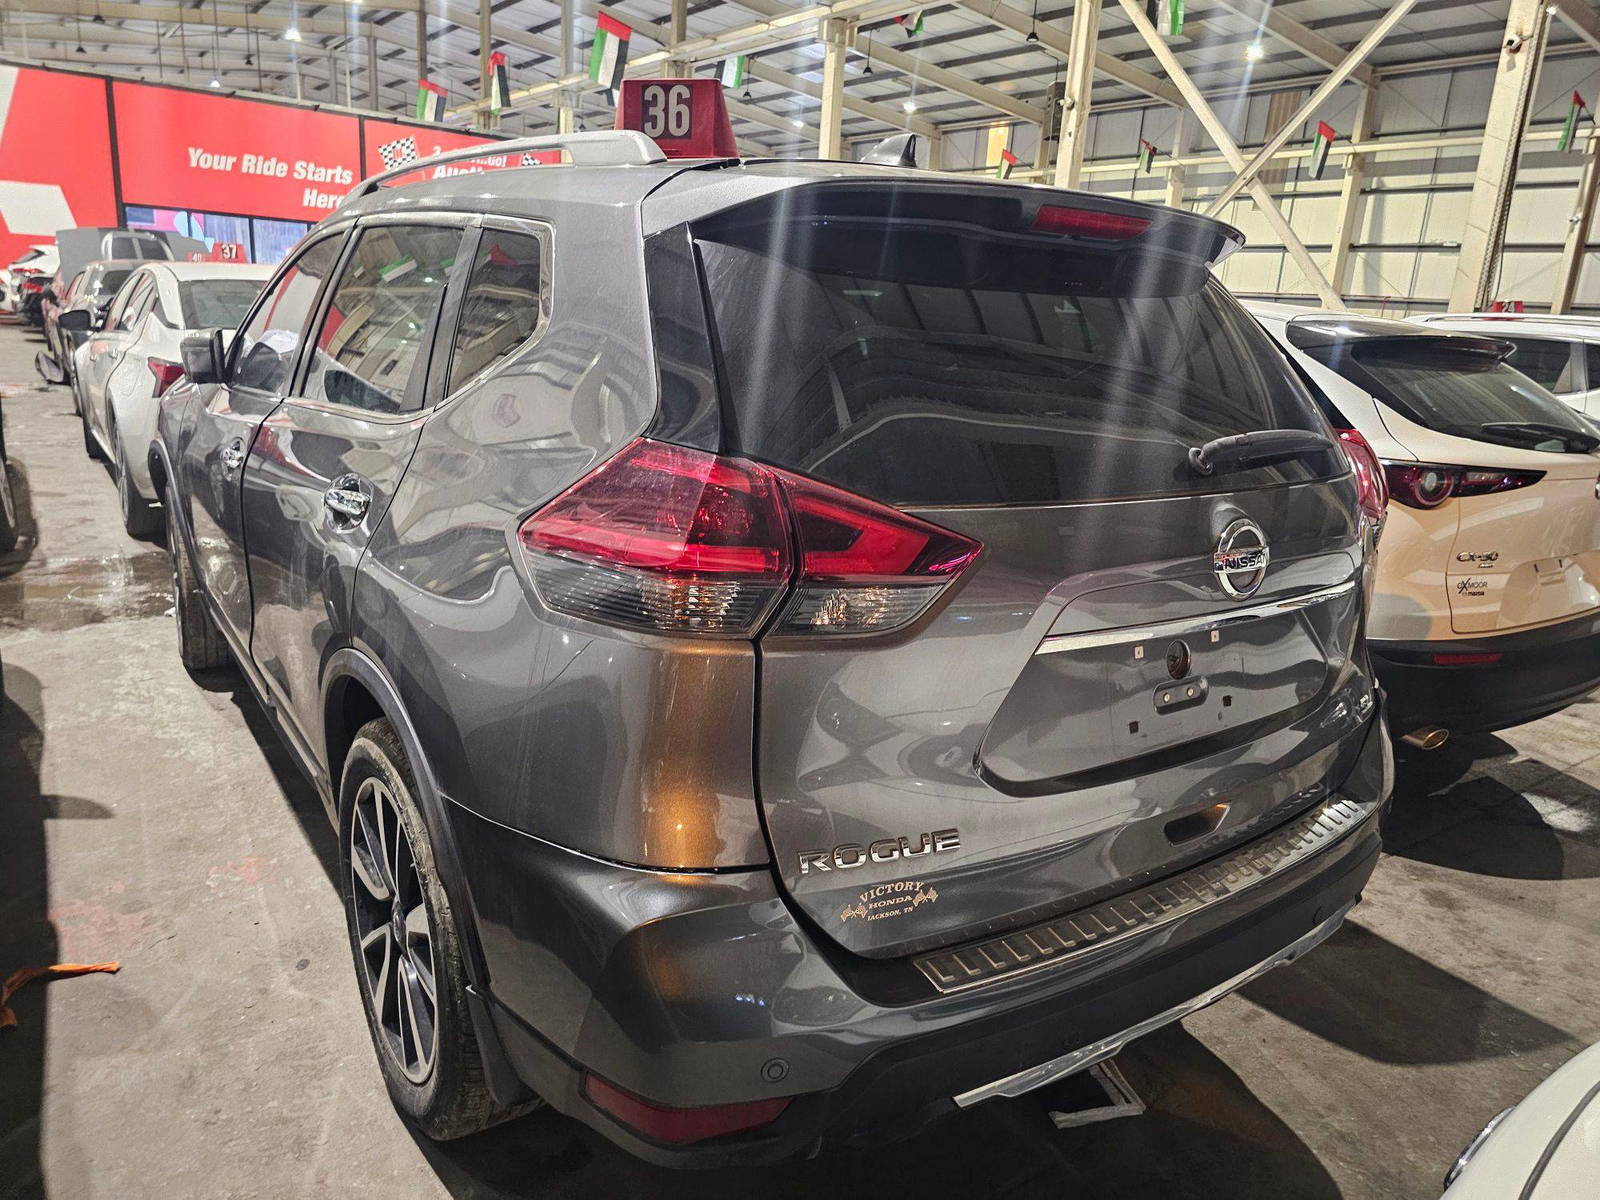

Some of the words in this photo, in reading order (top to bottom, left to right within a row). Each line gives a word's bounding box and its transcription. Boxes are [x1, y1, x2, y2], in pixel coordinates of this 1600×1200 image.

[643, 84, 691, 138] 36
[187, 147, 237, 171] Your
[241, 153, 289, 178] Ride
[293, 160, 353, 185] Starts
[221, 243, 238, 260] 37
[797, 827, 962, 875] ROGUE
[859, 881, 925, 903] VICTORY
[868, 895, 914, 910] HONDA
[903, 905, 914, 915] TN
